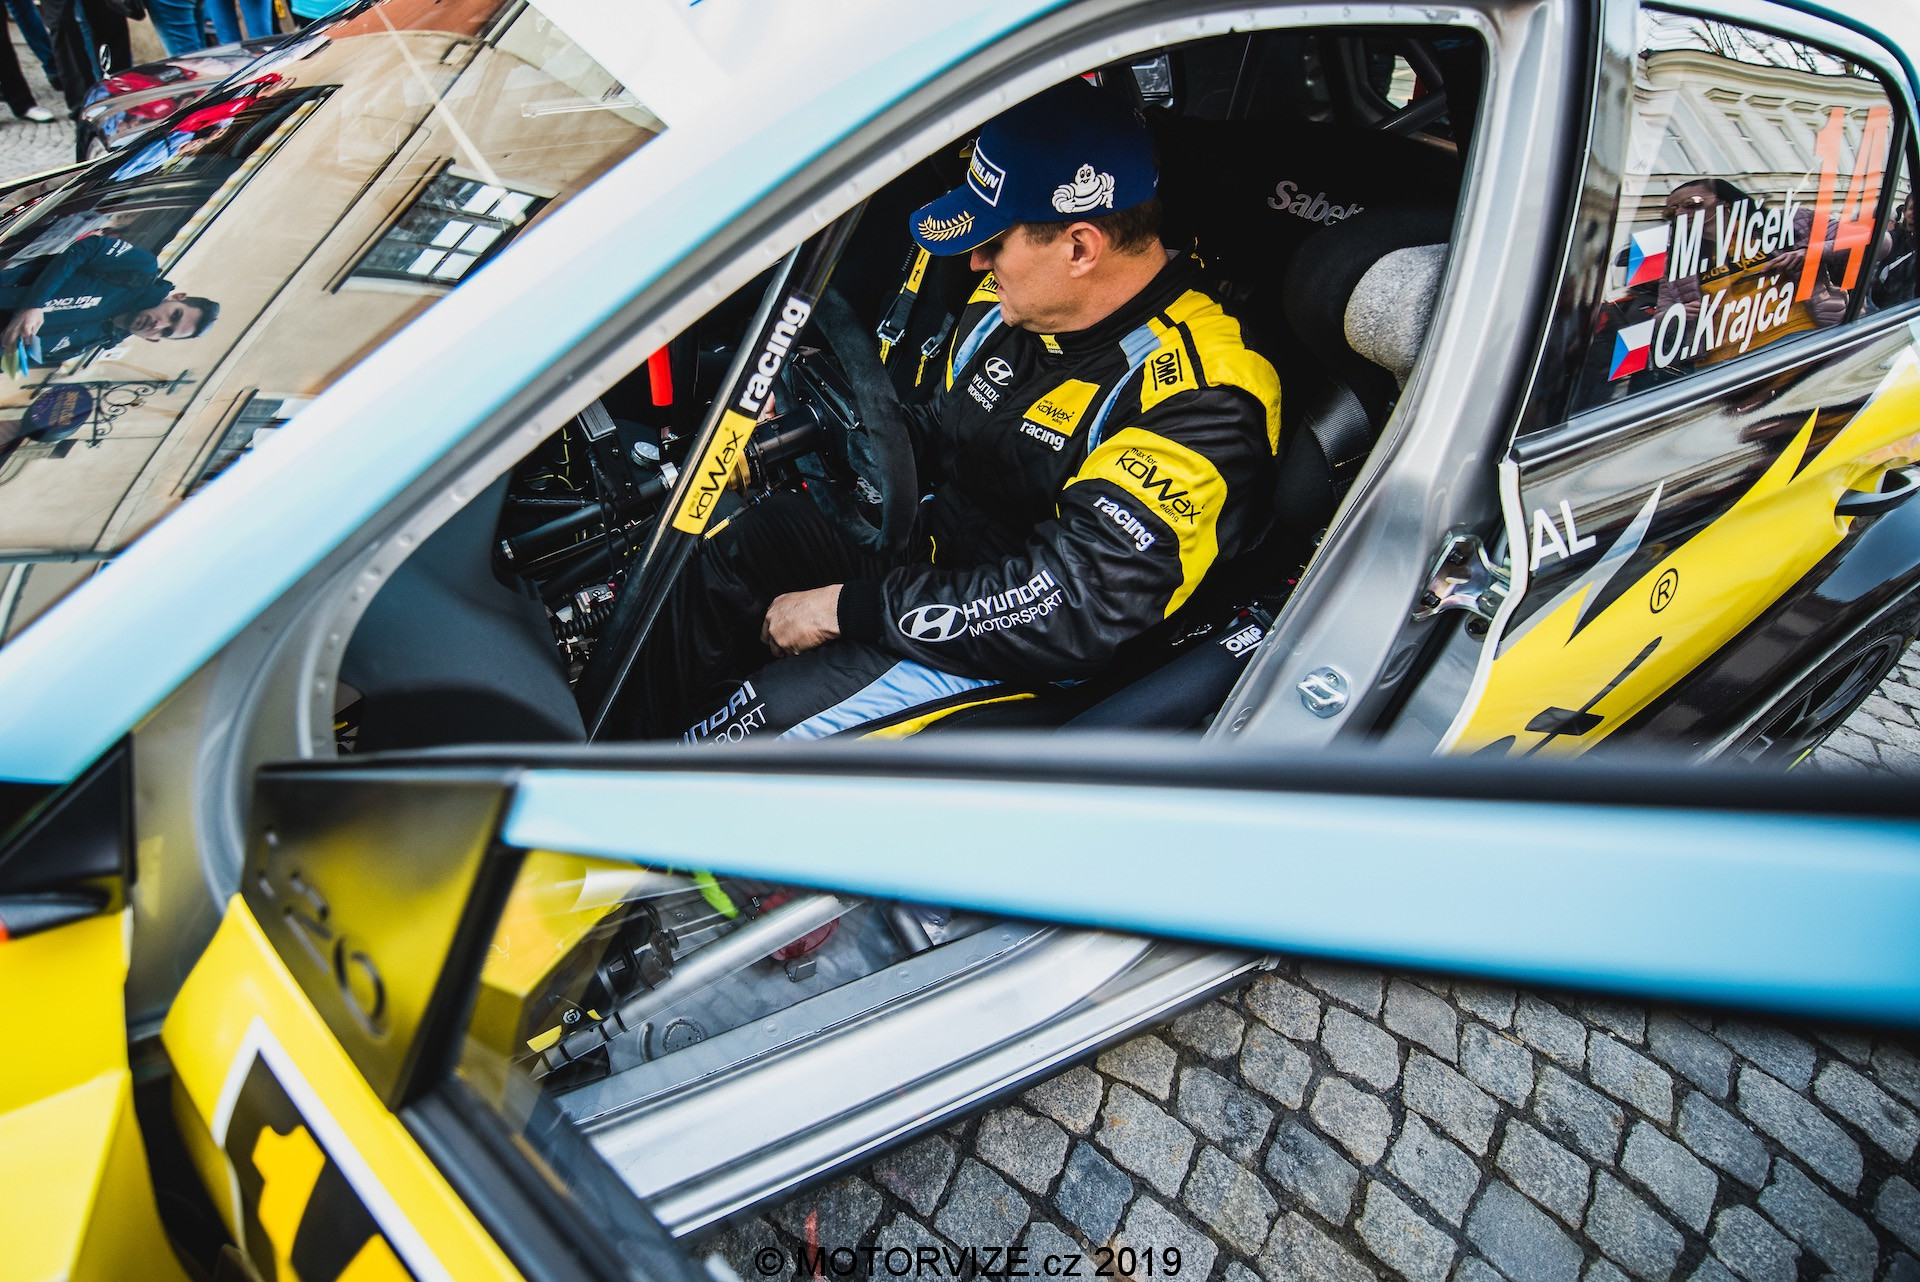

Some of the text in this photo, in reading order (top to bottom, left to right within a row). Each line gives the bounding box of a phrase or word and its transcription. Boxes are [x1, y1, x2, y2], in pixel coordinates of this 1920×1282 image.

[1795, 107, 1889, 302] 14
[1669, 188, 1801, 283] M.Vlček
[1654, 274, 1795, 369] O.Krajča
[739, 296, 812, 412] racing
[1155, 352, 1178, 386] OMP
[1019, 421, 1065, 452] racing
[1131, 447, 1157, 466] max for
[1093, 496, 1156, 552] racing
[1529, 500, 1597, 572] AL
[961, 570, 1056, 621] HYUNDAI
[968, 589, 1063, 637] MOTORSPORT
[1225, 627, 1262, 652] OMP
